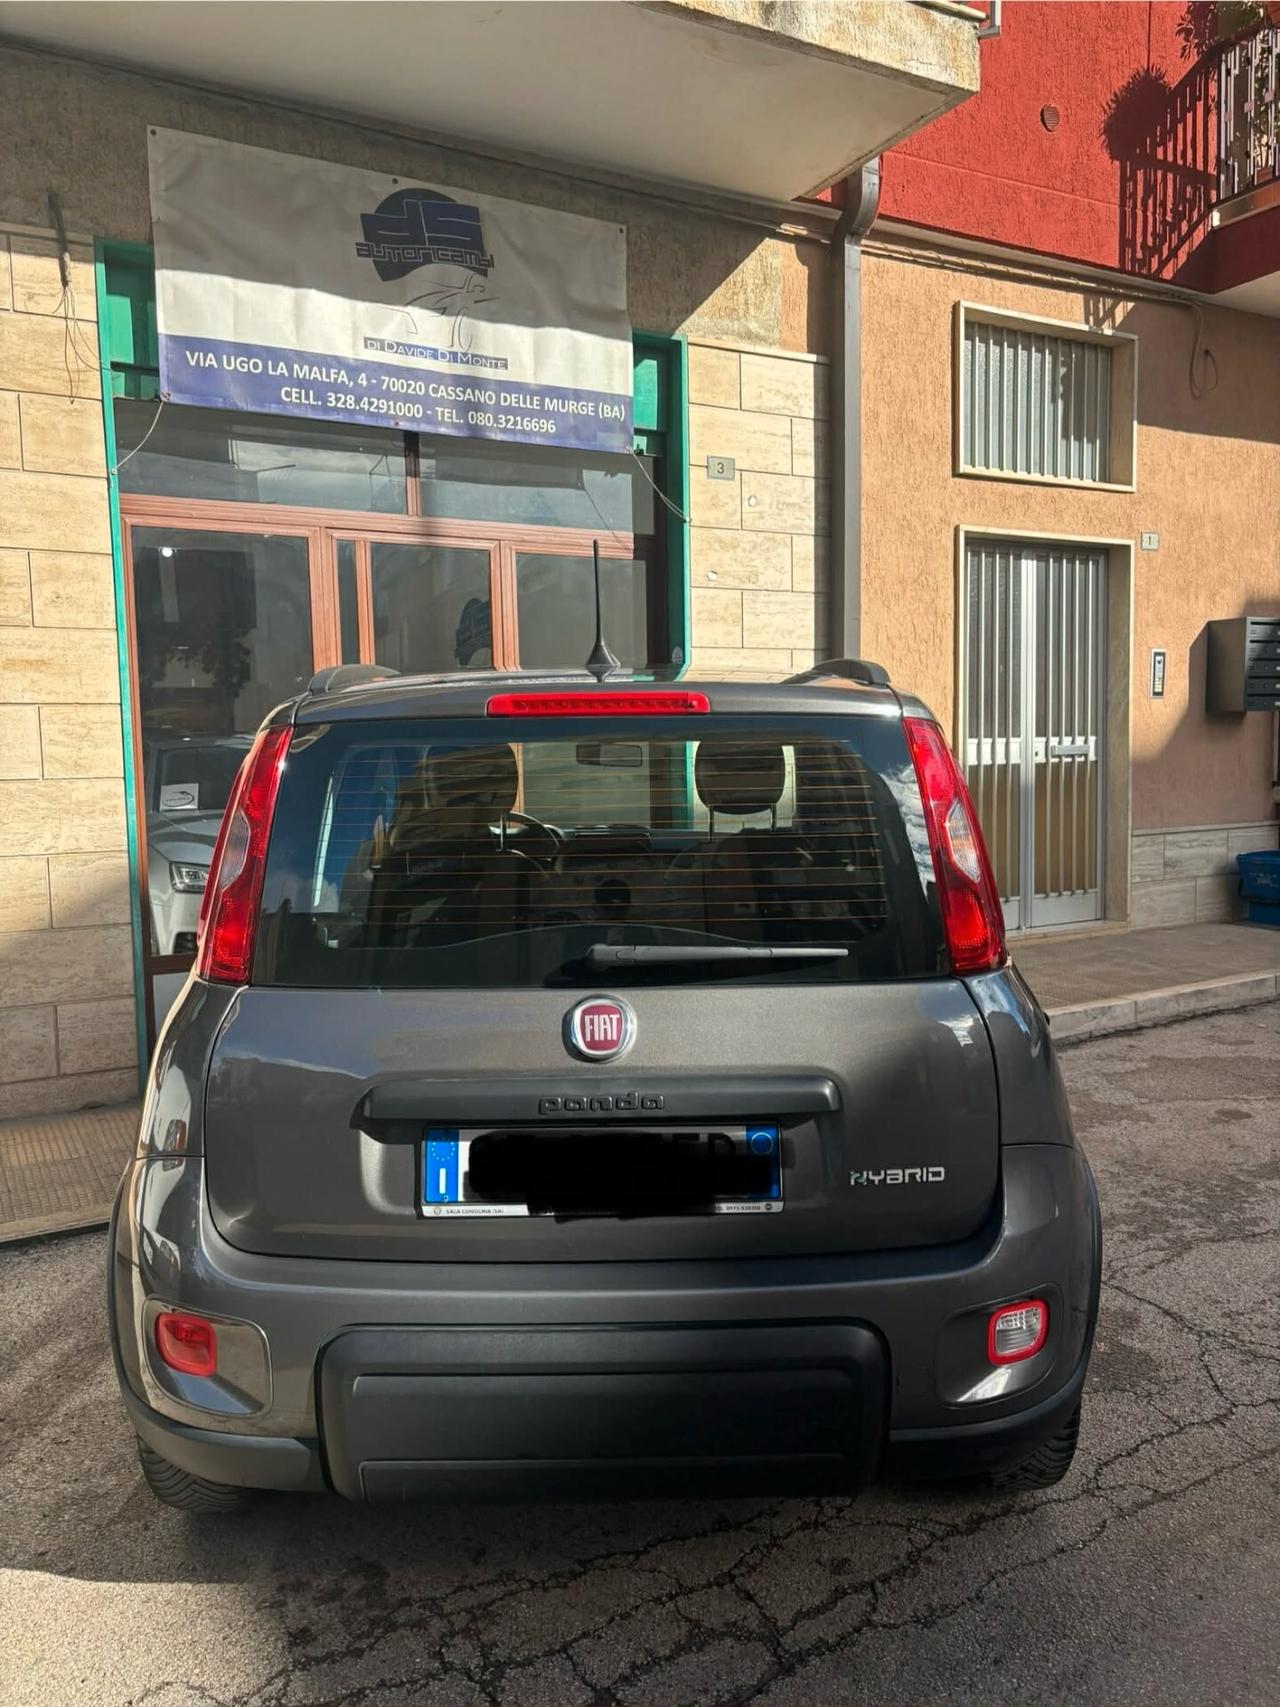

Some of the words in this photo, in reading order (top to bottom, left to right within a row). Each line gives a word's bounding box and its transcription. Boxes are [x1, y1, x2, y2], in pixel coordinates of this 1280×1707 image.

[186, 351, 218, 369] VIA
[222, 355, 263, 374] UGO
[268, 361, 289, 377] LA
[293, 364, 354, 387] MALFA,
[357, 373, 368, 387] 4
[381, 376, 425, 396] 70020
[428, 383, 496, 406] CASSANO
[500, 392, 541, 411] DELLE
[544, 397, 596, 416] MURGE
[598, 402, 625, 421] (BA)
[280, 386, 322, 406] CELL.
[327, 391, 423, 419] 328.4291000
[435, 406, 464, 424] TEL.
[468, 410, 556, 433] 080.3216696
[717, 462, 725, 475] 3
[584, 1014, 621, 1042] FIAT
[538, 1089, 664, 1116] panda
